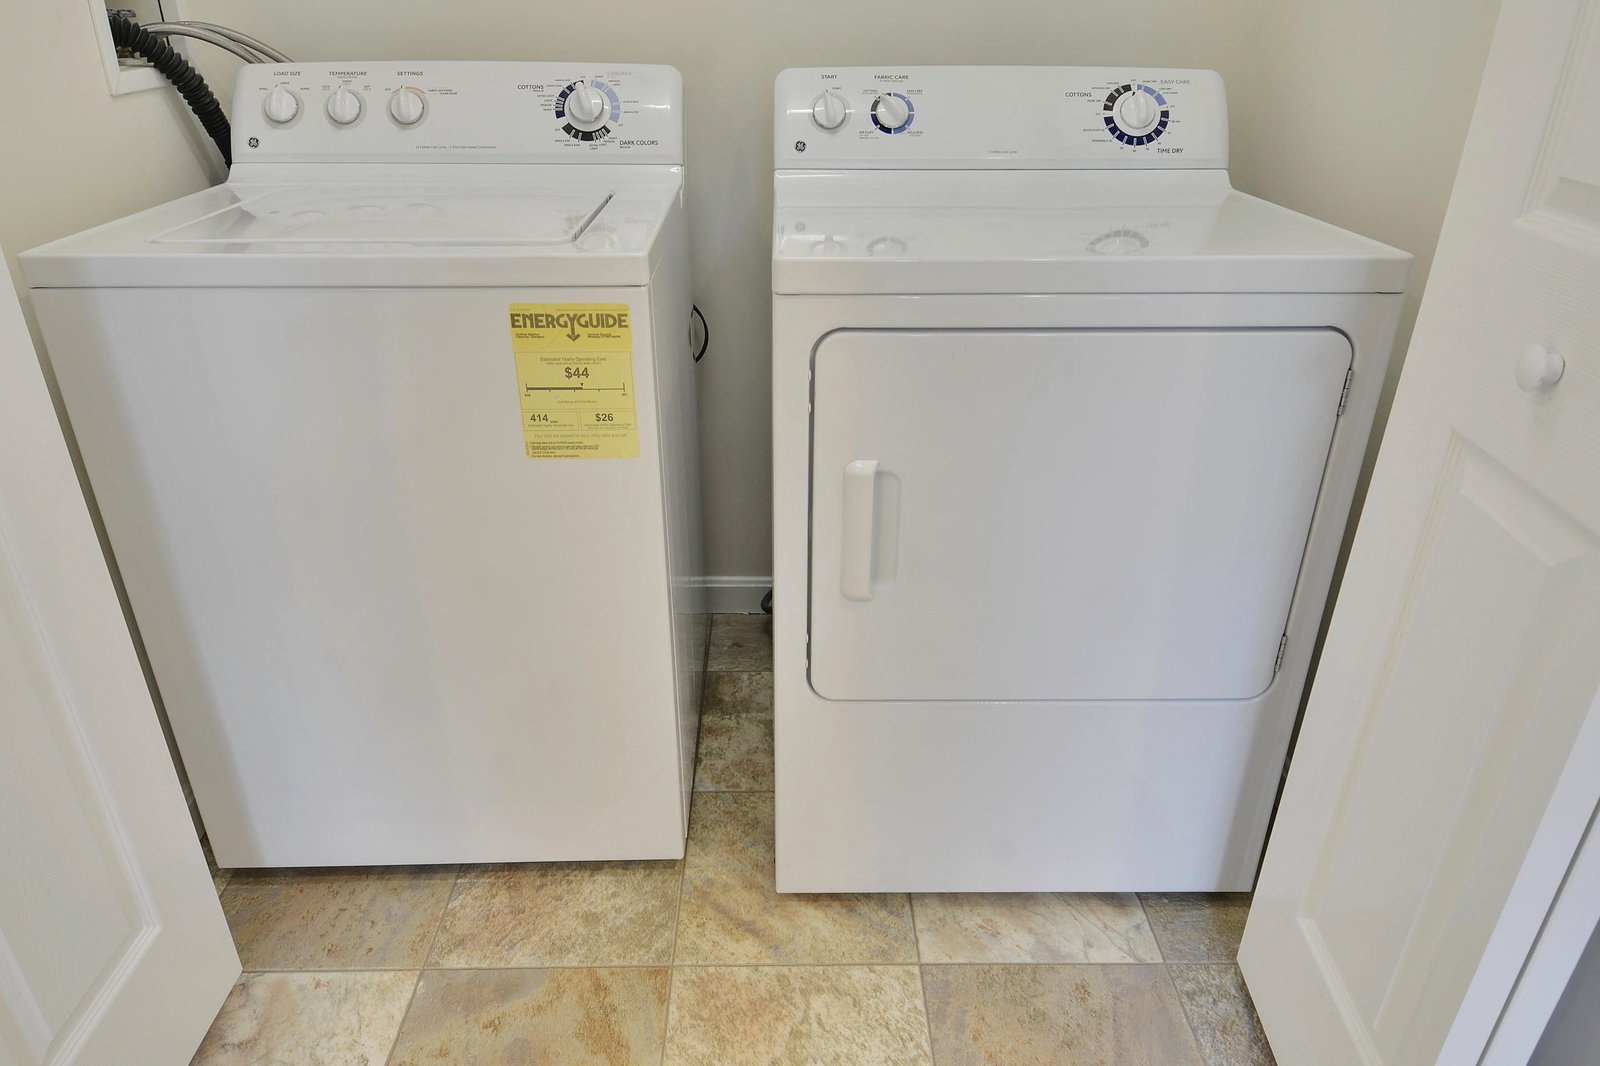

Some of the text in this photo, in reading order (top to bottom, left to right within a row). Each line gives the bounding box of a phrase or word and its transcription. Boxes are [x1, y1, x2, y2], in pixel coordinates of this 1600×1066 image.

[510, 313, 628, 328] ENERGYGUIDE
[565, 366, 589, 379] $44
[530, 414, 548, 422] 414
[595, 413, 614, 422] $26
